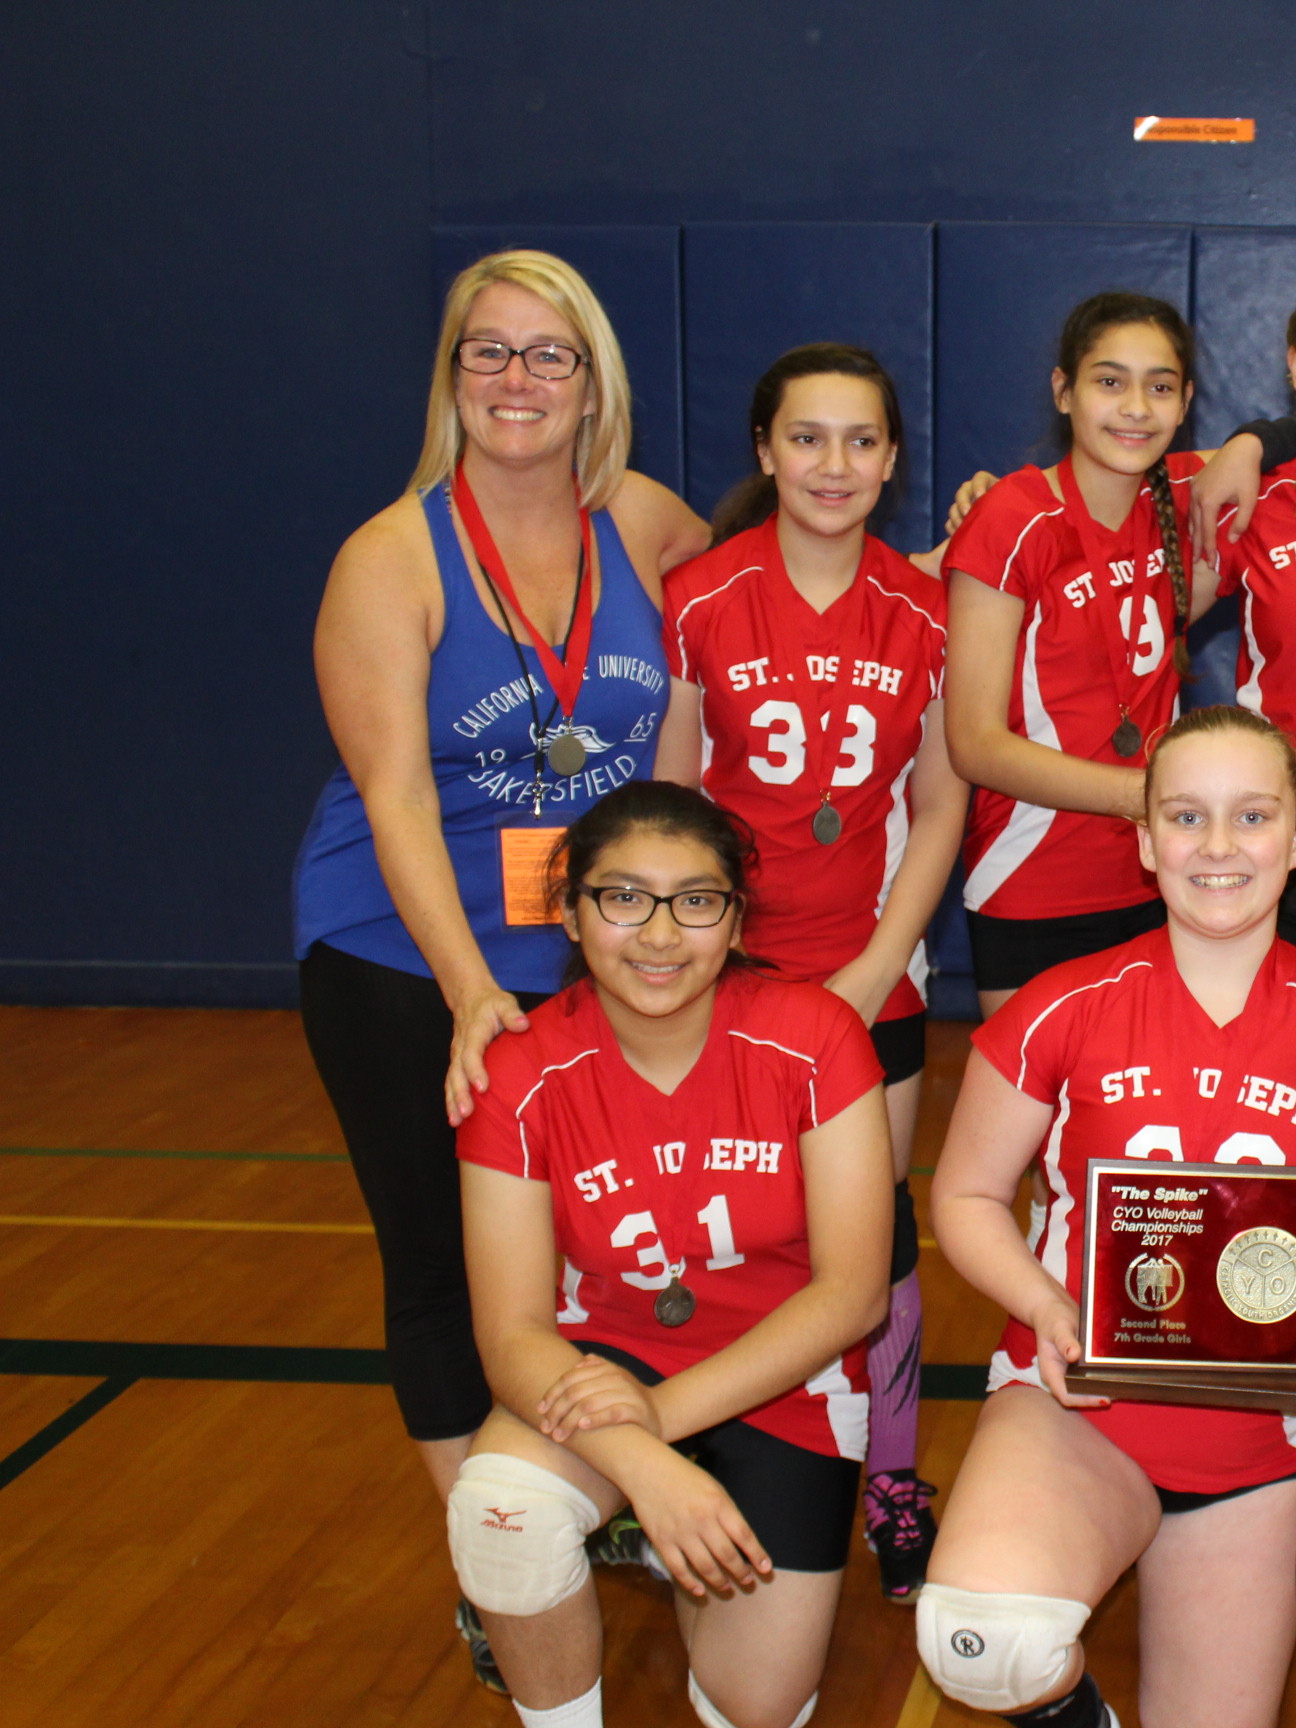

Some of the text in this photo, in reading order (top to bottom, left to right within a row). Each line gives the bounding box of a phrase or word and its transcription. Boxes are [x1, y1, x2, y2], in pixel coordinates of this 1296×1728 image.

[727, 656, 779, 692] ST.
[453, 673, 544, 738] CALIFORNIA
[598, 655, 664, 695] UNIVERSITY
[748, 699, 877, 787] 33
[1101, 1066, 1161, 1104] ST.
[573, 1159, 634, 1203] ST.
[1111, 1186, 1208, 1203] "The Spike"
[1113, 1206, 1204, 1222] CYO Volleyball
[1111, 1219, 1204, 1236] Championships
[610, 1194, 745, 1291] 31
[1141, 1234, 1173, 1246] 2017
[1238, 1304, 1264, 1319] YOUTH
[1121, 1318, 1186, 1330] Second Place
[1114, 1332, 1192, 1344] 7th Grade Girls
